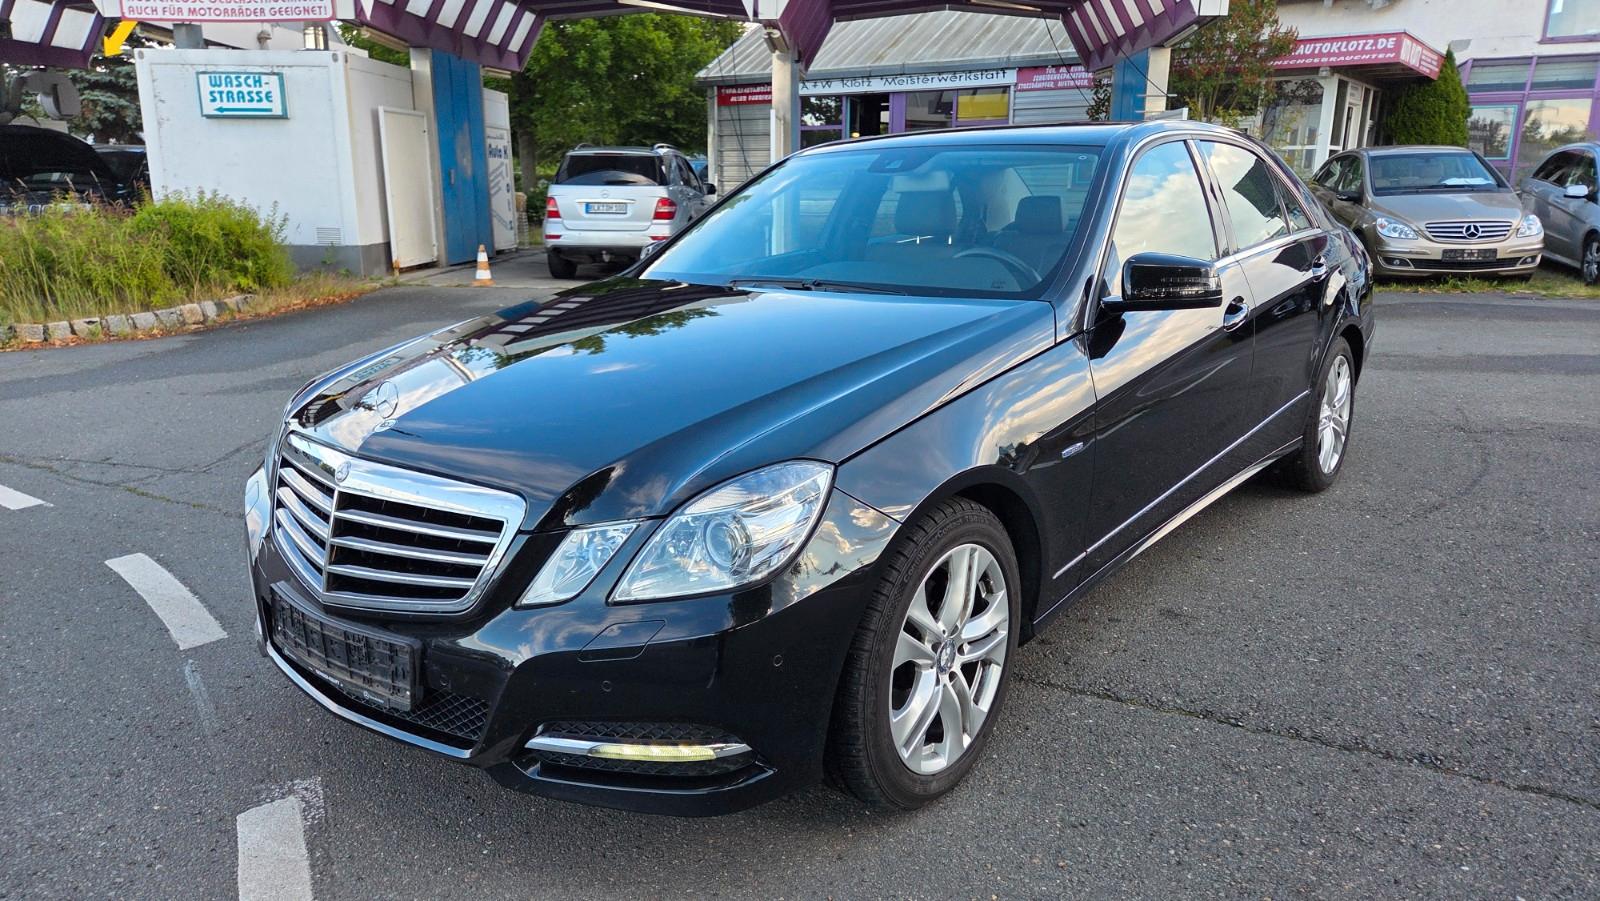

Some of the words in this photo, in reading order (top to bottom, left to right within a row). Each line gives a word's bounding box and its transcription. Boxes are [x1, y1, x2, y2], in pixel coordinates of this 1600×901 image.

[128, 6, 158, 16] AUCH
[162, 5, 183, 16] FÜR
[188, 5, 266, 17] MOTORRÄDER
[269, 6, 328, 16] GEEIGNET!
[1289, 37, 1397, 56] .AUTOKLOTZ.DE
[1267, 52, 1396, 66] UNSCHGEBRAUCHTEN
[208, 75, 270, 88] WASCH-
[841, 77, 873, 89] Klotz
[209, 90, 273, 103] STRASSE
